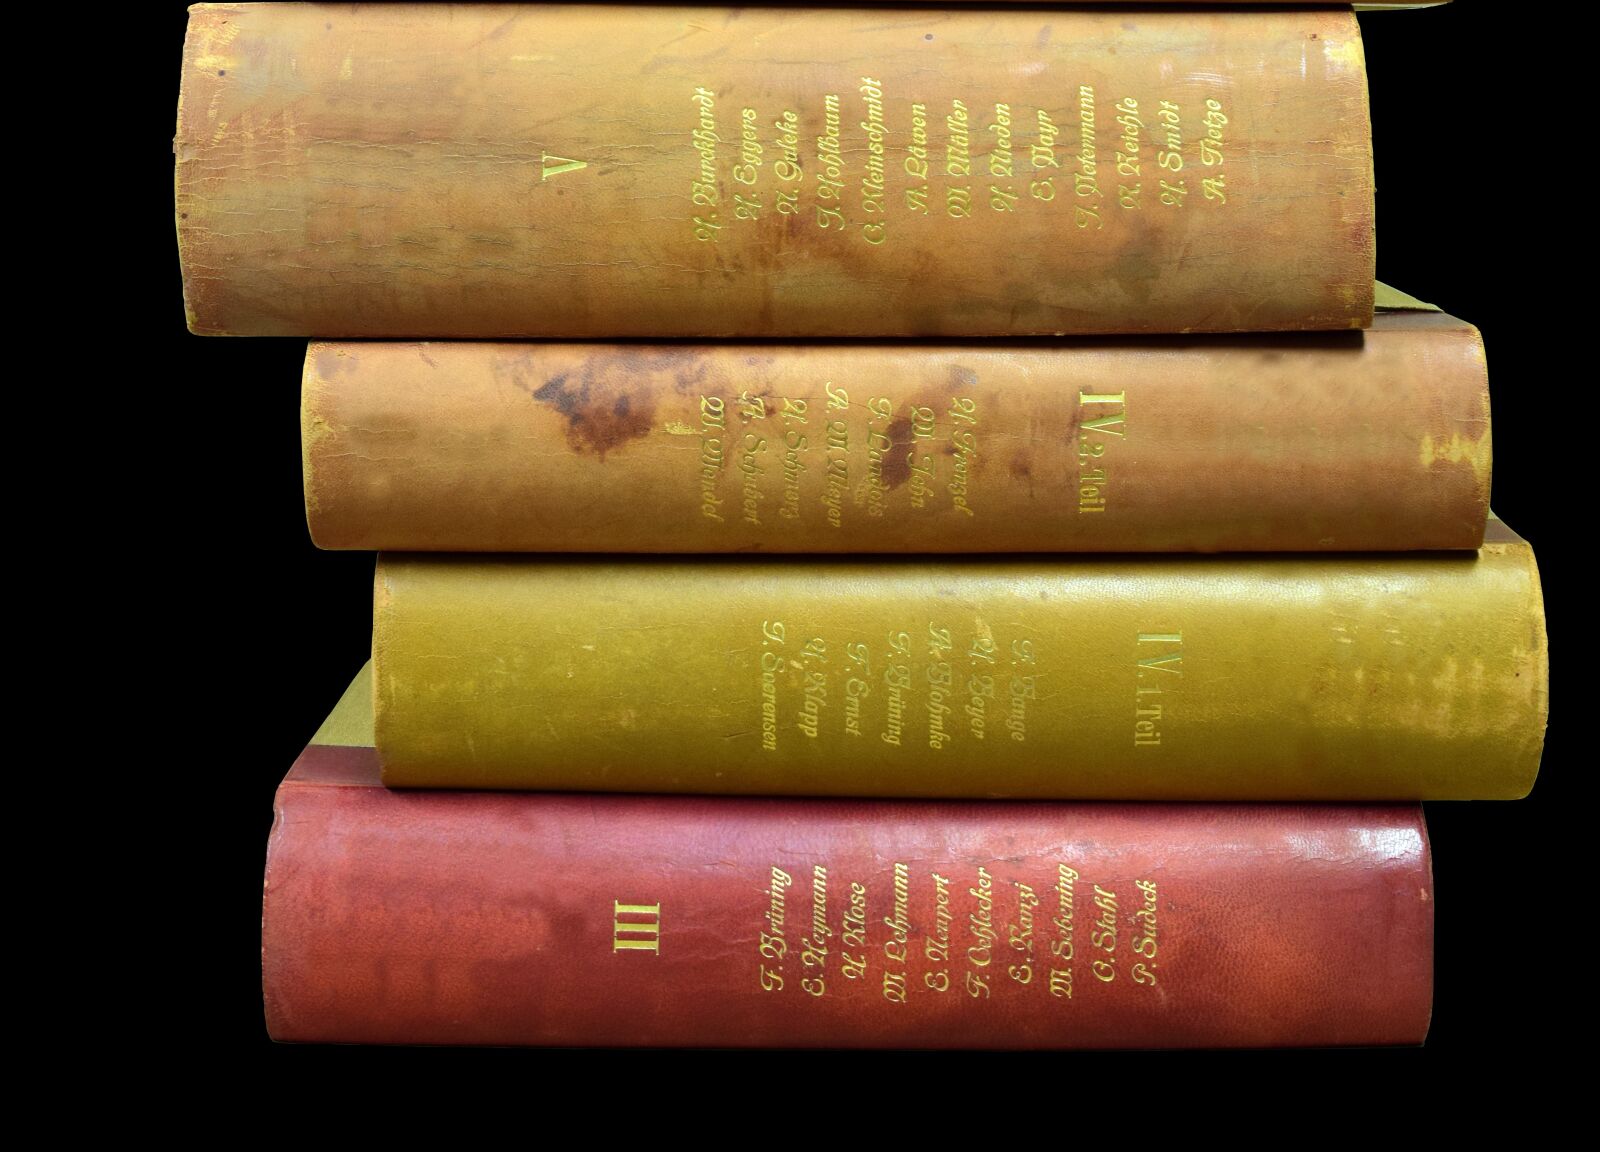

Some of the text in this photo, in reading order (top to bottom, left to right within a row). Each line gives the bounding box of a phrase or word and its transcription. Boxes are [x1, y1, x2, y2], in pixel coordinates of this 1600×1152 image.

[541, 150, 588, 181] V
[692, 87, 720, 206] Burckhardt
[733, 108, 763, 185] Eggers
[774, 111, 803, 182] Guleke
[816, 95, 845, 199] Hohlbaum
[860, 77, 889, 213] Kleinschmidt
[904, 104, 928, 215] A. Läwen
[989, 103, 1012, 176] Nieden
[1074, 86, 1103, 197] Petermann
[1158, 101, 1183, 172] Smidt
[1200, 99, 1228, 204] A. Tietze
[1031, 177, 1055, 201] E.
[868, 397, 892, 424] F.
[738, 391, 768, 525] A. Schubert
[845, 643, 870, 736] F. Ernst
[881, 664, 912, 746] Brüning
[965, 674, 995, 738] Beyer
[614, 900, 660, 956] III
[760, 866, 792, 990] F. Brüning
[801, 866, 832, 996] E. Heymann
[842, 882, 865, 946] Klose
[884, 863, 911, 964] Lehmann
[924, 874, 952, 991] E. Neupert
[966, 867, 998, 998] F. Oehlecker
[1051, 864, 1078, 960] Sebening
[1092, 885, 1118, 952] Stahl
[1132, 880, 1156, 986] P. Sudeck
[1008, 958, 1032, 984] E.
